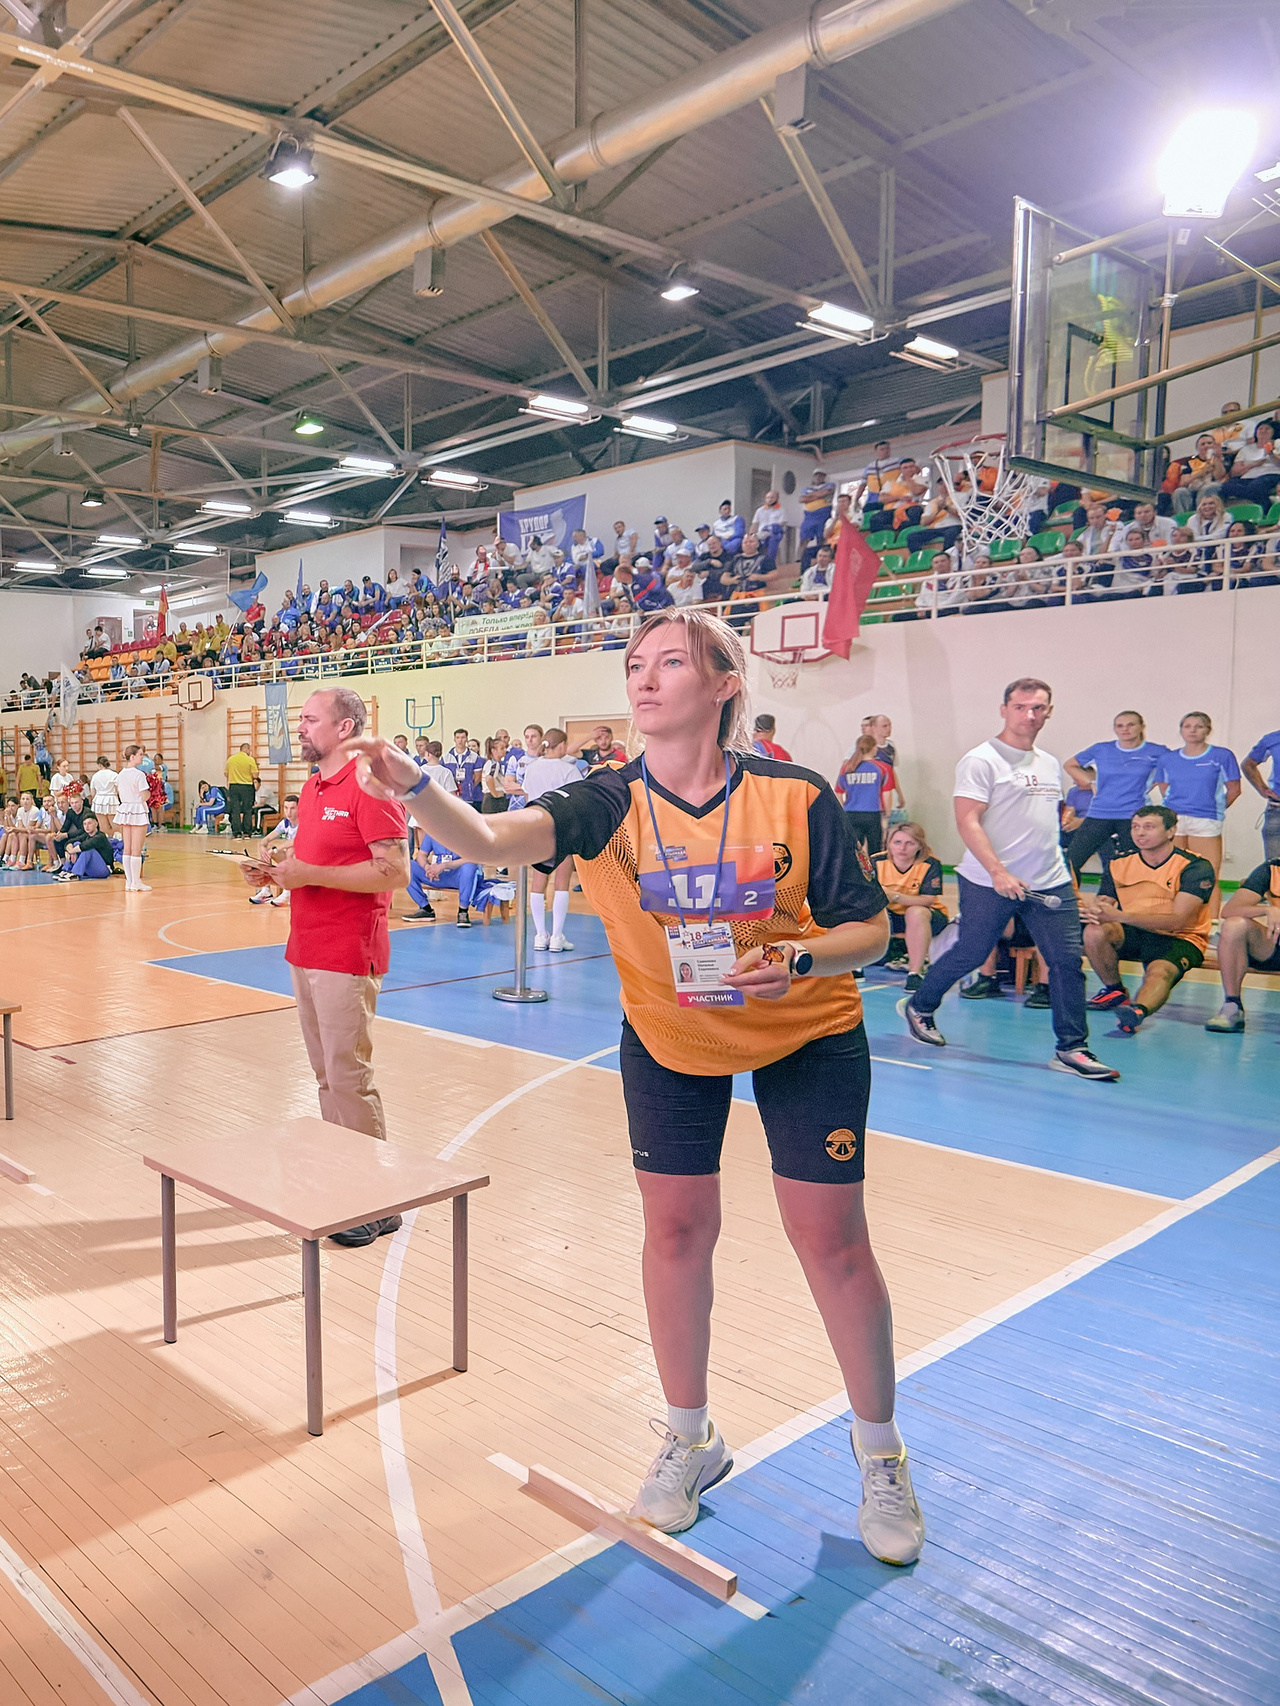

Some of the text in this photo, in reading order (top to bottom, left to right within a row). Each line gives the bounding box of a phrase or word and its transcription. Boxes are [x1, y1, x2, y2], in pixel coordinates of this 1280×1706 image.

[482, 616, 508, 625] Только
[1025, 775, 1038, 787] 18
[668, 874, 721, 909] 11
[743, 890, 758, 906] 2
[690, 932, 702, 942] 18
[687, 994, 733, 1003] УЧАСТНИК
